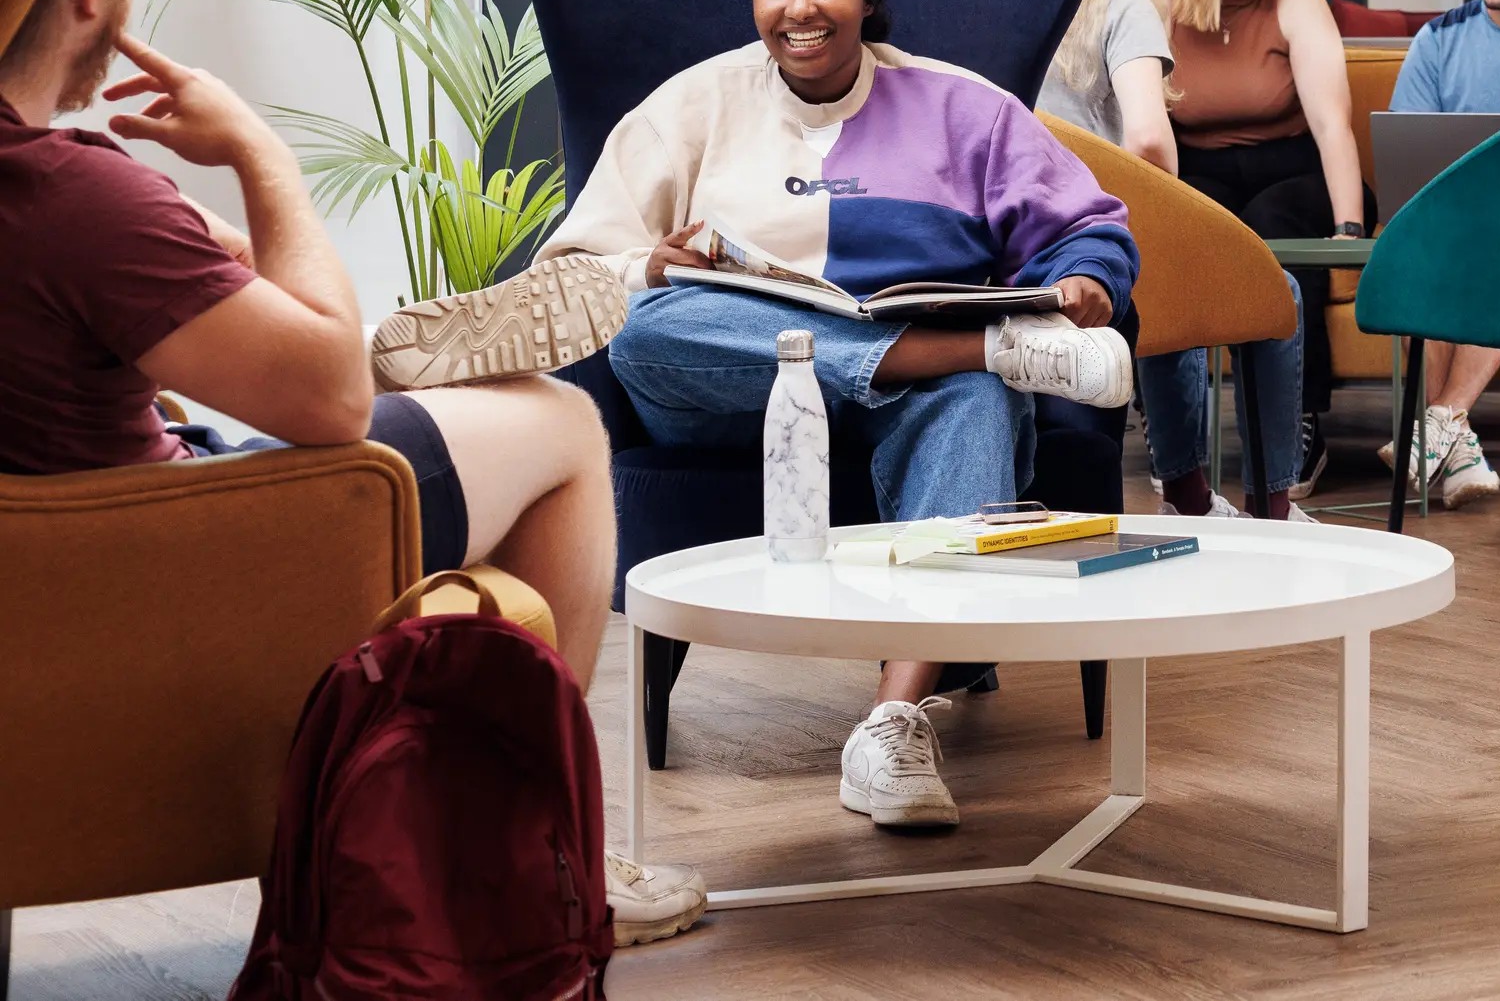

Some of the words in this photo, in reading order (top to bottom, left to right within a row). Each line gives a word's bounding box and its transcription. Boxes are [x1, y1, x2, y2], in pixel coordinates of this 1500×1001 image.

[784, 176, 868, 196] OFCL
[513, 278, 529, 309] NIKE
[982, 538, 1004, 548] DYNAMIC
[1004, 534, 1029, 544] IDENTITIES
